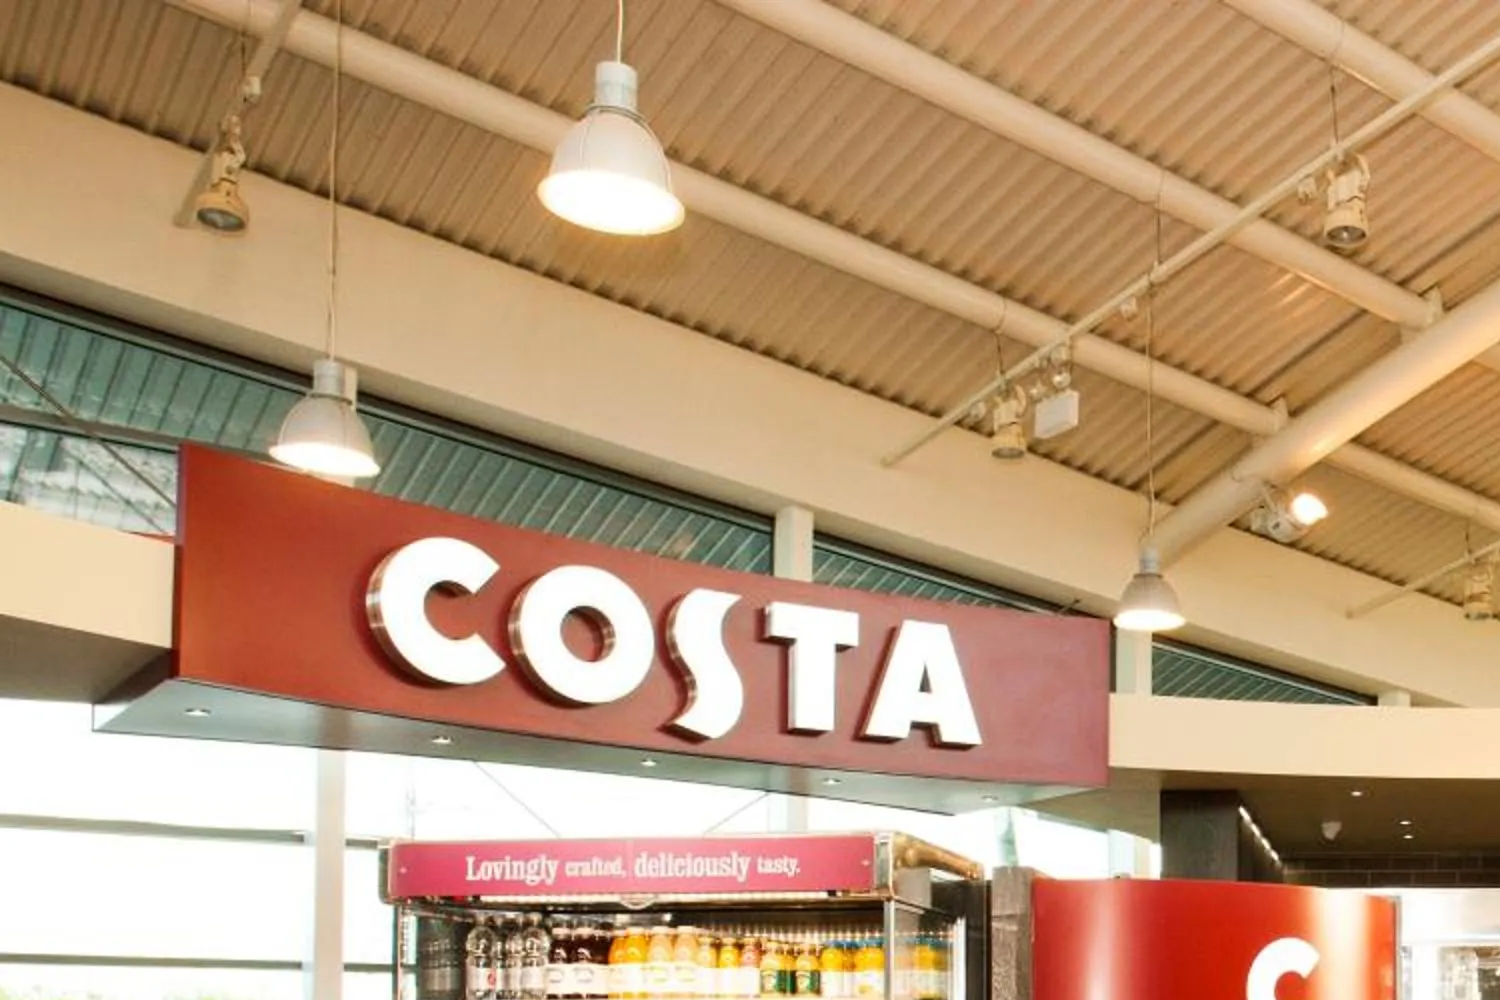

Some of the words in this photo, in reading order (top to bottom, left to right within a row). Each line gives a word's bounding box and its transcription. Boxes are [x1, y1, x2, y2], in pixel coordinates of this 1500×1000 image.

[365, 536, 983, 747] COSTA
[465, 855, 560, 886] Lovingly
[565, 857, 627, 878] crafted,
[634, 851, 752, 882] deliciously
[757, 856, 801, 878] tasty.
